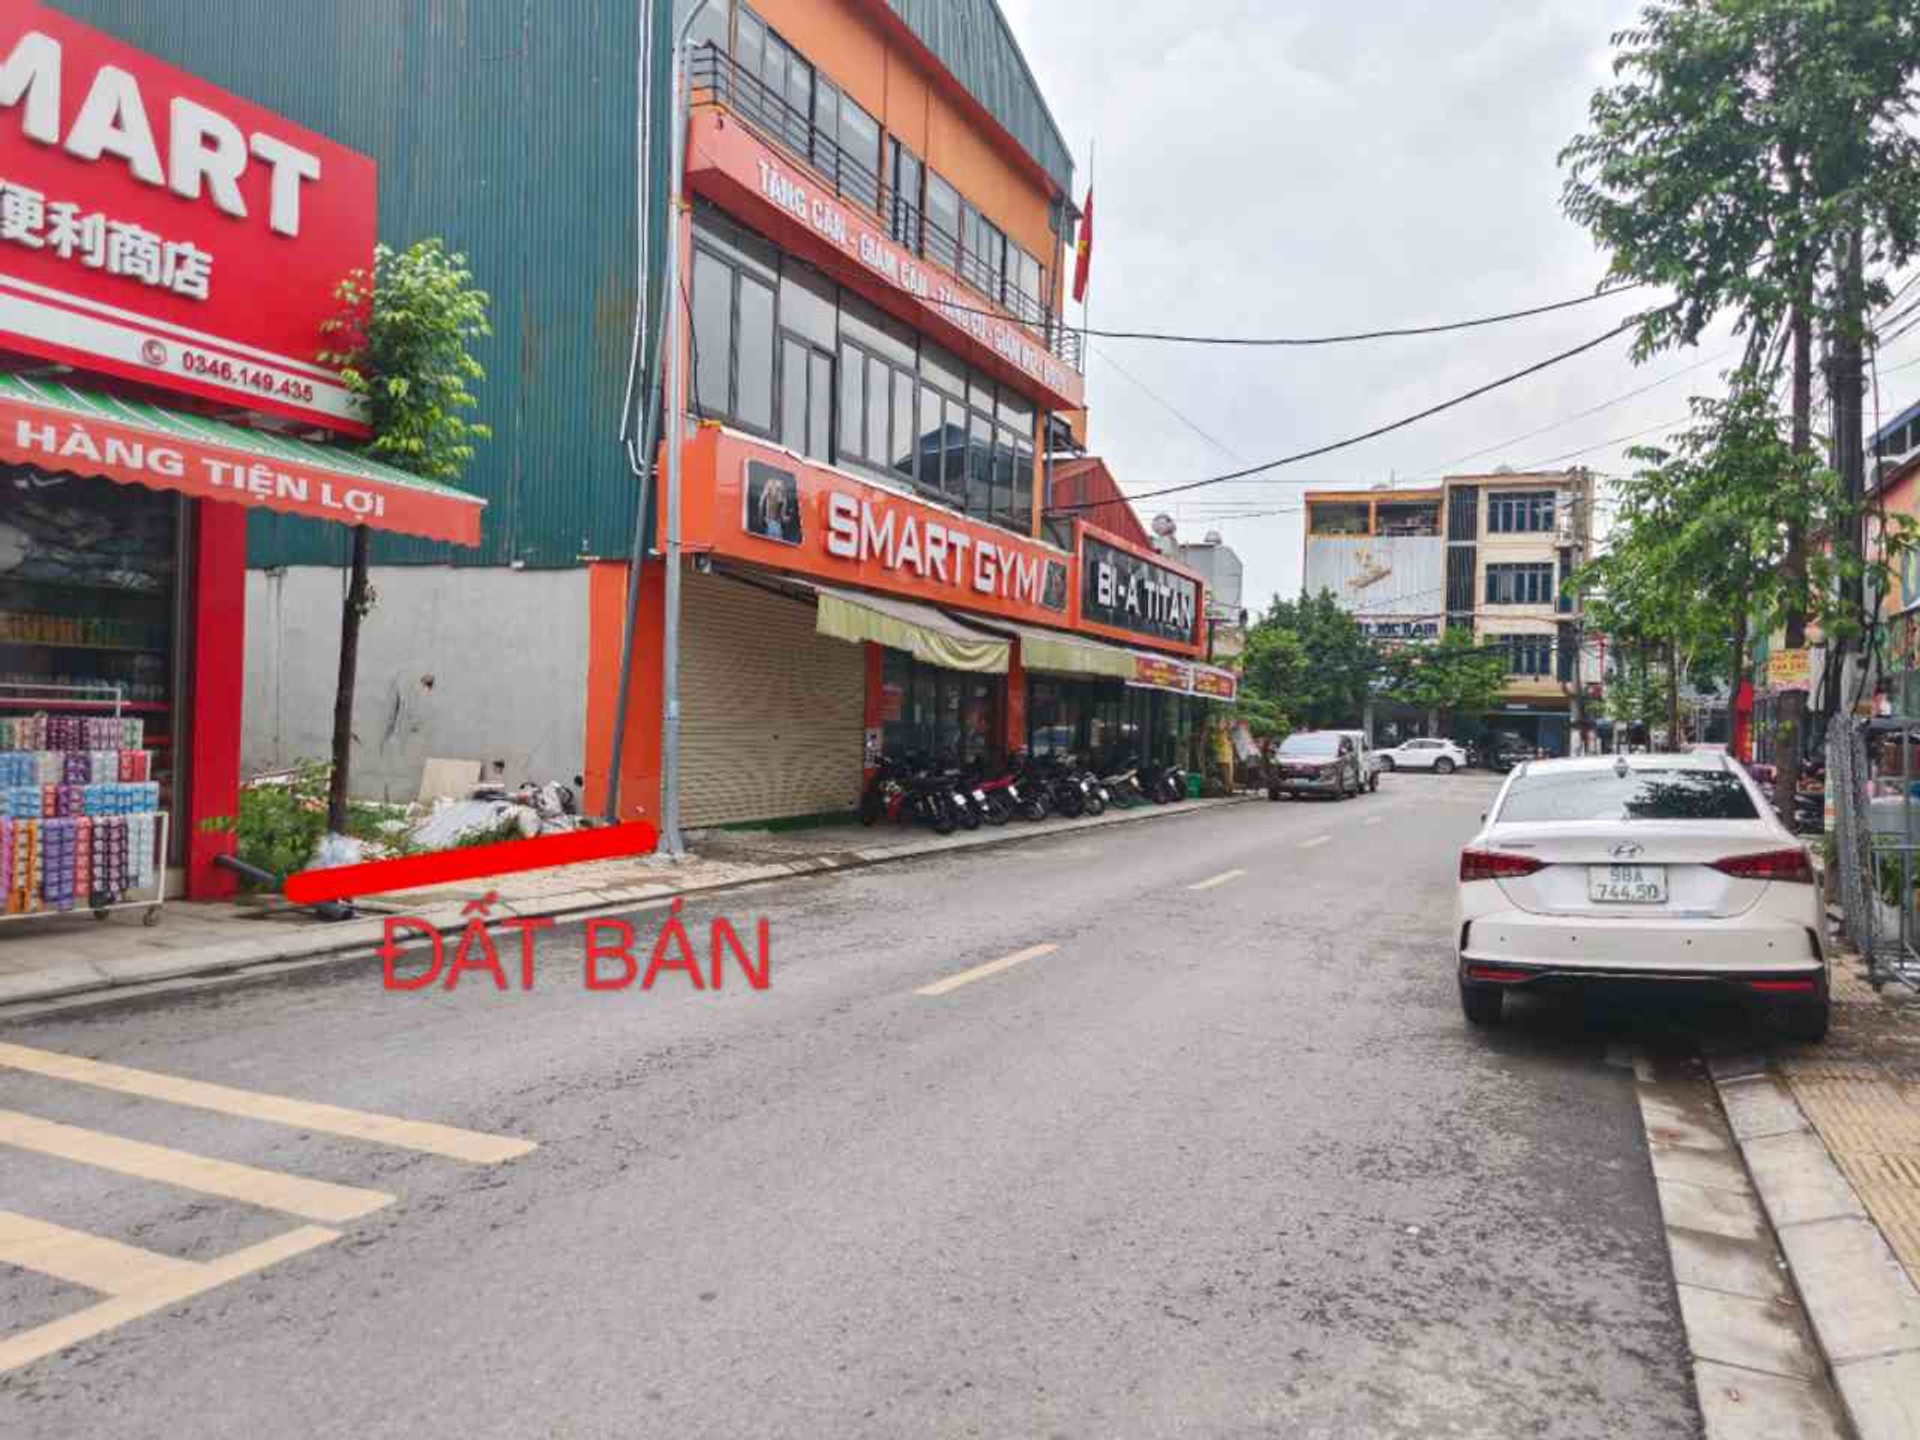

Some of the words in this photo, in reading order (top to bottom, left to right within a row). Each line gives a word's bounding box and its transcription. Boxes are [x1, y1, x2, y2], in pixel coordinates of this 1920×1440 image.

[0, 30, 322, 238] MART
[181, 350, 314, 403] 0346.149.435
[15, 419, 186, 477] HÀNG
[201, 457, 309, 502] TIỆN
[320, 481, 385, 521] LỢI
[1097, 561, 1141, 616] BI-A
[1143, 579, 1192, 630] TITAN
